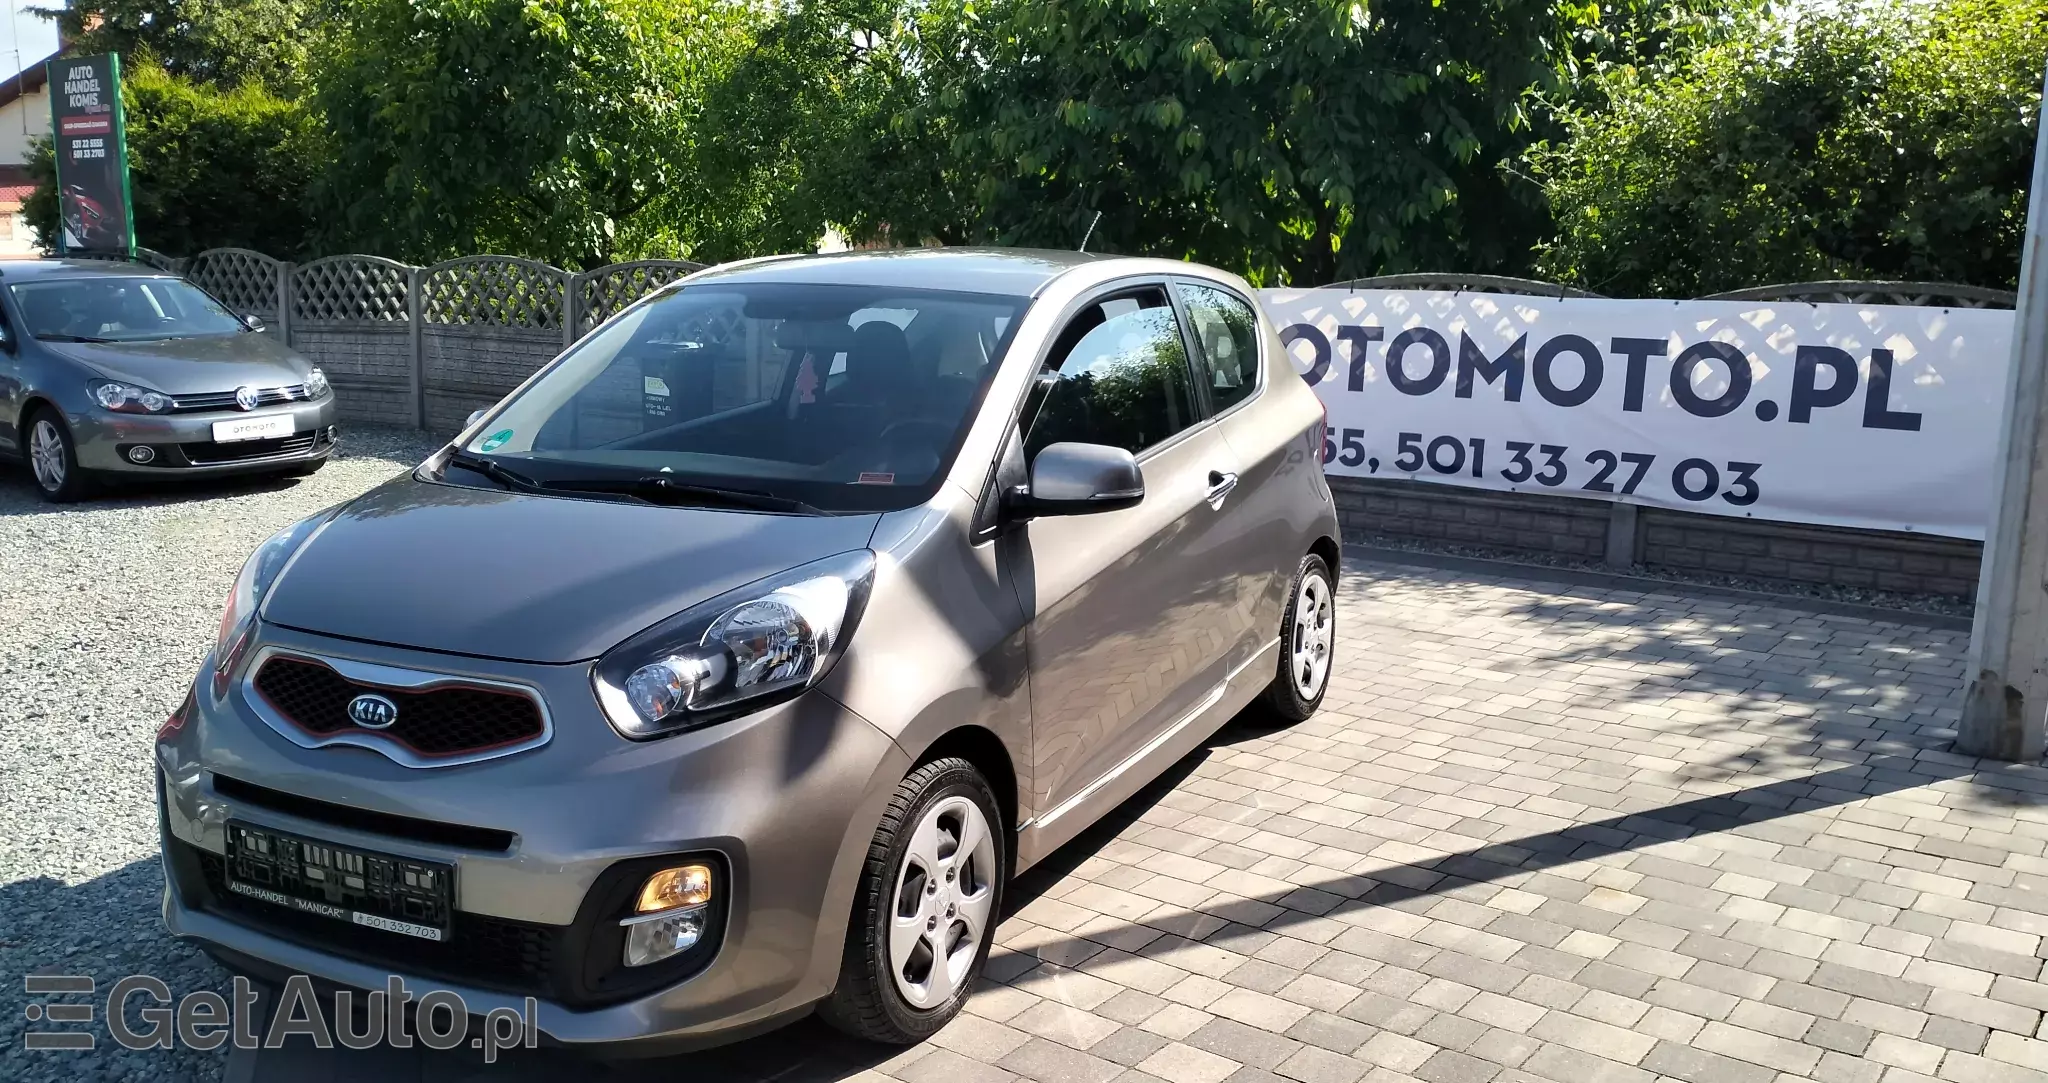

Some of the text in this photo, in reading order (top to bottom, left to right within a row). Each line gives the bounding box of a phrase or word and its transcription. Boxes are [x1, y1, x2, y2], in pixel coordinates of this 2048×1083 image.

[68, 66, 93, 80] AUTO
[64, 79, 100, 94] HANDEL
[69, 93, 98, 107] KOMIS
[1278, 323, 1922, 432] OTOMOTO.PL
[1394, 432, 1485, 478] 501
[1500, 441, 1568, 487] 33
[1581, 450, 1656, 495] 27
[1671, 458, 1763, 506] 03
[354, 701, 386, 722] KIA
[230, 881, 289, 905] AUTO-HANDEL
[366, 916, 437, 939] 501 332 703
